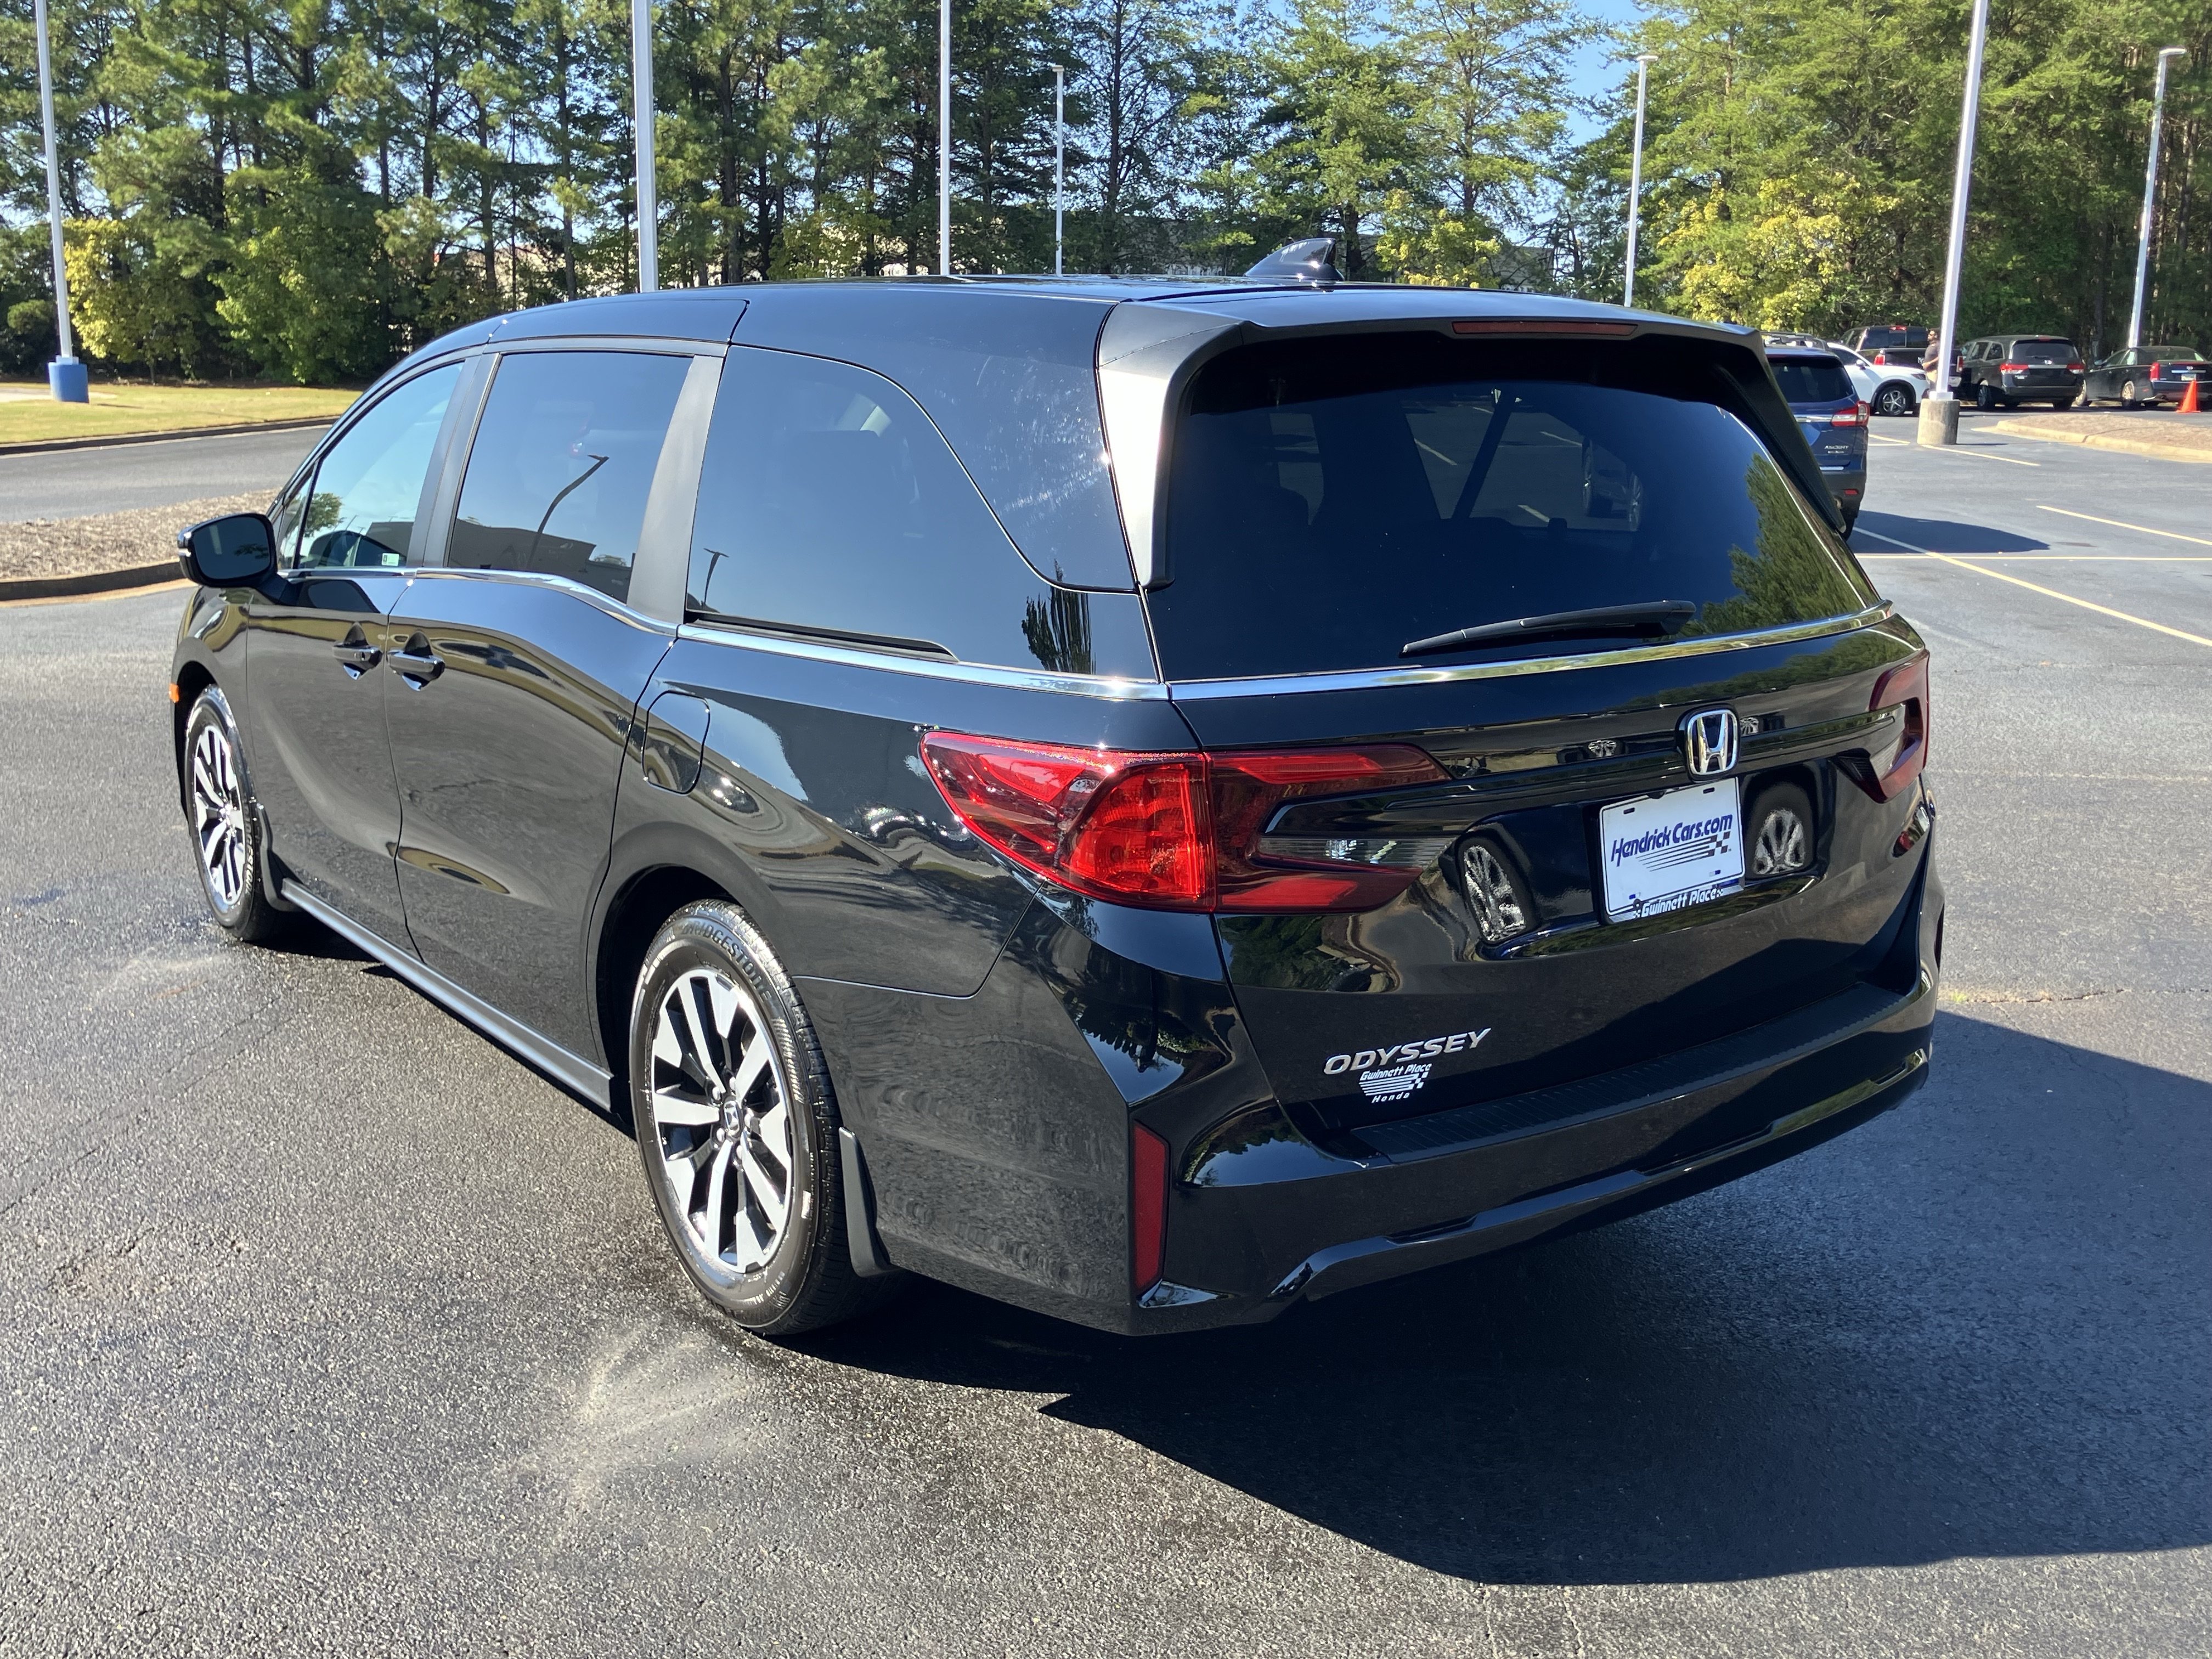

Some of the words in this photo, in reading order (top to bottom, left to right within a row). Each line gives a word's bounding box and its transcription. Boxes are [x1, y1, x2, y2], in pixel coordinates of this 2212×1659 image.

[1641, 892, 1688, 917] Gwinnett
[1689, 888, 1717, 906] Place
[1323, 1028, 1492, 1075] ODYSSEY
[1360, 1065, 1404, 1081] Gwinnett
[1404, 1063, 1432, 1075] Place
[1372, 1092, 1410, 1103] Honda
